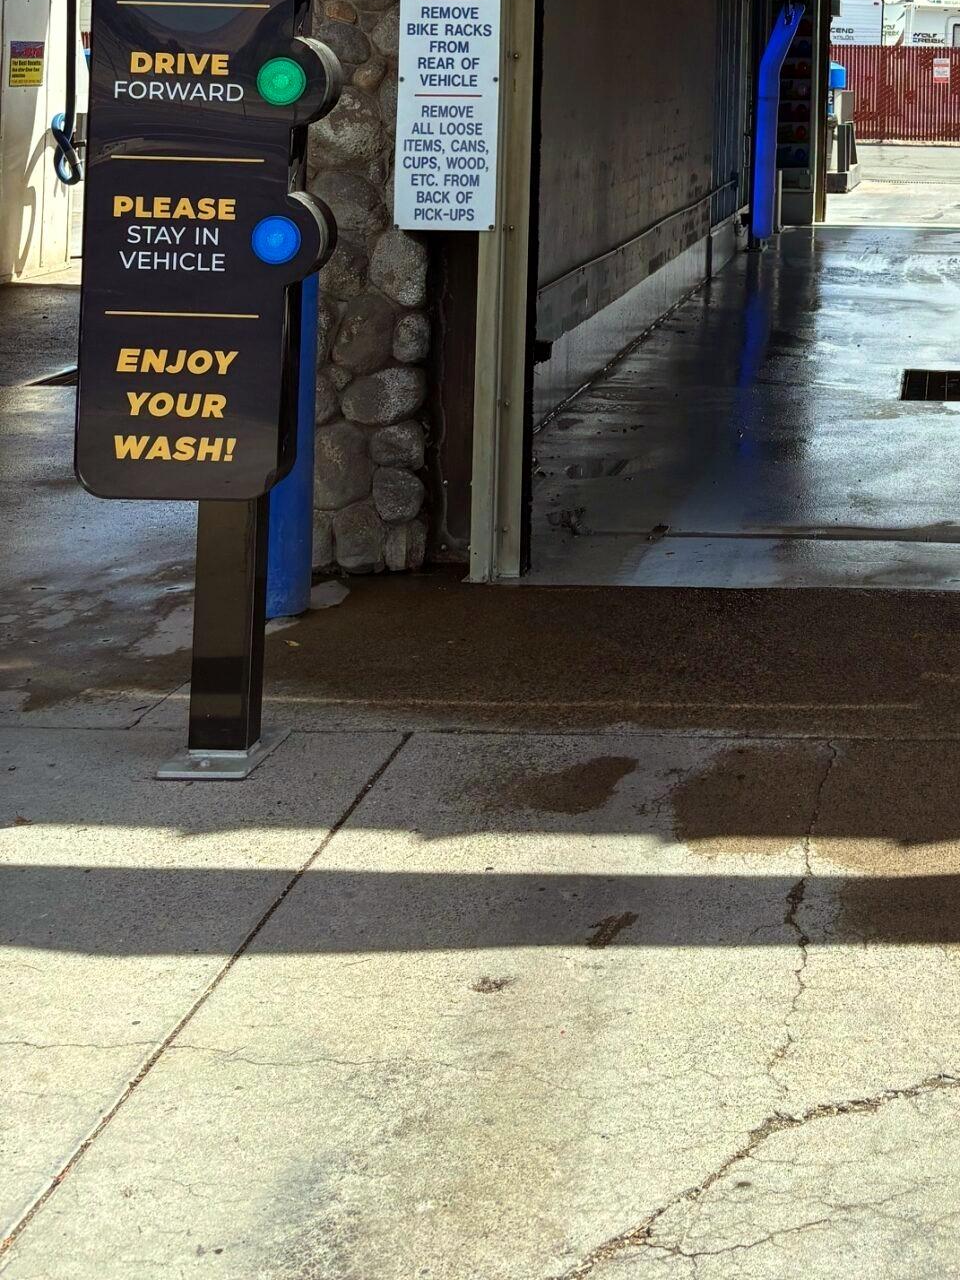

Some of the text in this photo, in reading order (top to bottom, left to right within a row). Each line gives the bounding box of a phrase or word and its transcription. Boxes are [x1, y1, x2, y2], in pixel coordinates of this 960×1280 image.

[421, 6, 479, 19] REMOVE
[407, 23, 493, 37] BIKE RACKS
[429, 41, 470, 53] FROM
[130, 51, 229, 76] DRIVE
[417, 57, 480, 70] REAR OF
[420, 74, 478, 87] VEHICLE
[114, 80, 244, 102] FORWARD
[421, 105, 474, 118] REMOVE
[411, 122, 483, 136] ALL LOOSE
[403, 139, 489, 155] ITEMS, CANS,
[403, 156, 489, 172] CUPS, WOOD,
[410, 174, 480, 187] ETC. FROM
[416, 191, 473, 204] BACK OF
[113, 195, 236, 220] PLEASE
[414, 208, 475, 221] PICK-UPS
[127, 225, 219, 246] STAY IN
[119, 251, 226, 272] VEHICLE
[116, 348, 239, 375] ENJOY
[126, 391, 227, 419] YOUR
[113, 435, 237, 462] WASH!
